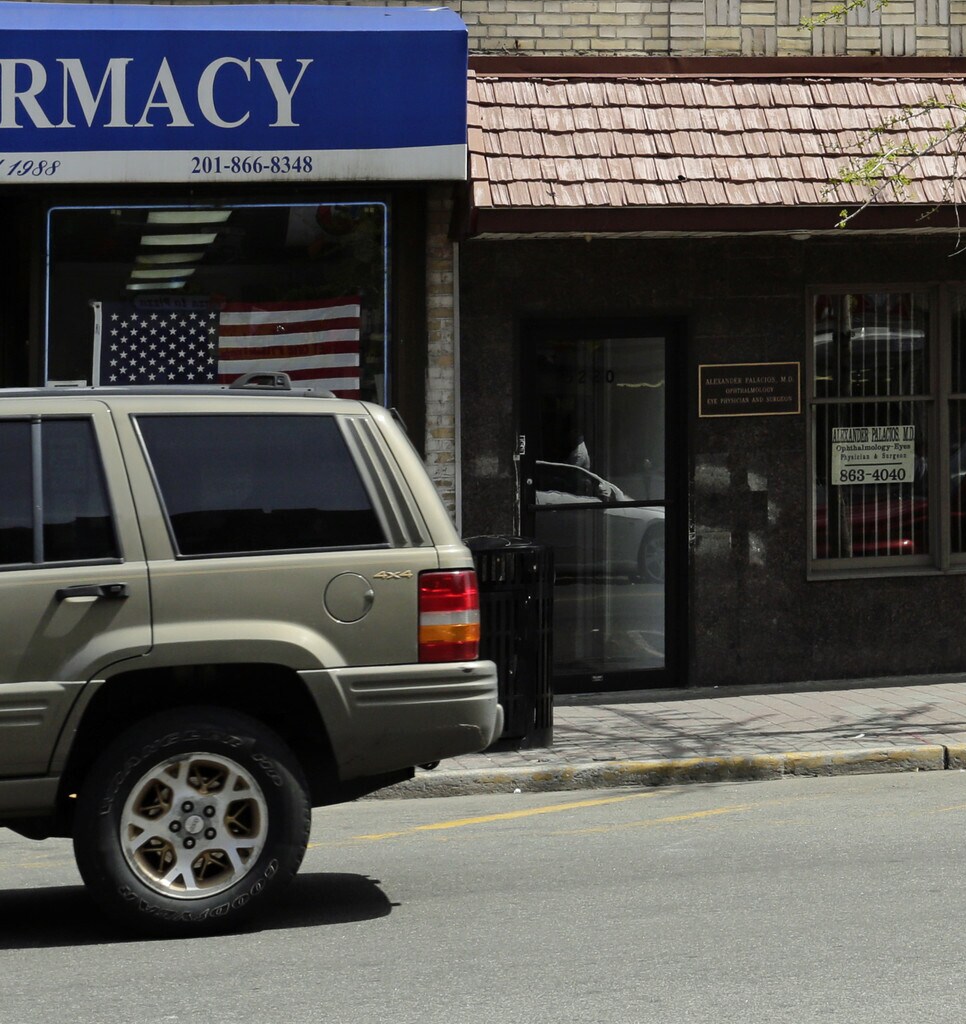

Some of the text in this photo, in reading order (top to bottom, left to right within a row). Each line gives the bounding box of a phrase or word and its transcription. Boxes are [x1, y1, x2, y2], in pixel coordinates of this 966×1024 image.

[0, 56, 314, 129] RMACY
[7, 159, 61, 177] 1988
[191, 156, 313, 174] 201-866-8348
[705, 377, 742, 385] ALEXANDER
[832, 428, 869, 443] ALEXANDER
[840, 453, 870, 461] Physician
[840, 468, 906, 482] 863-4040
[119, 858, 279, 922] GOODYEAR
